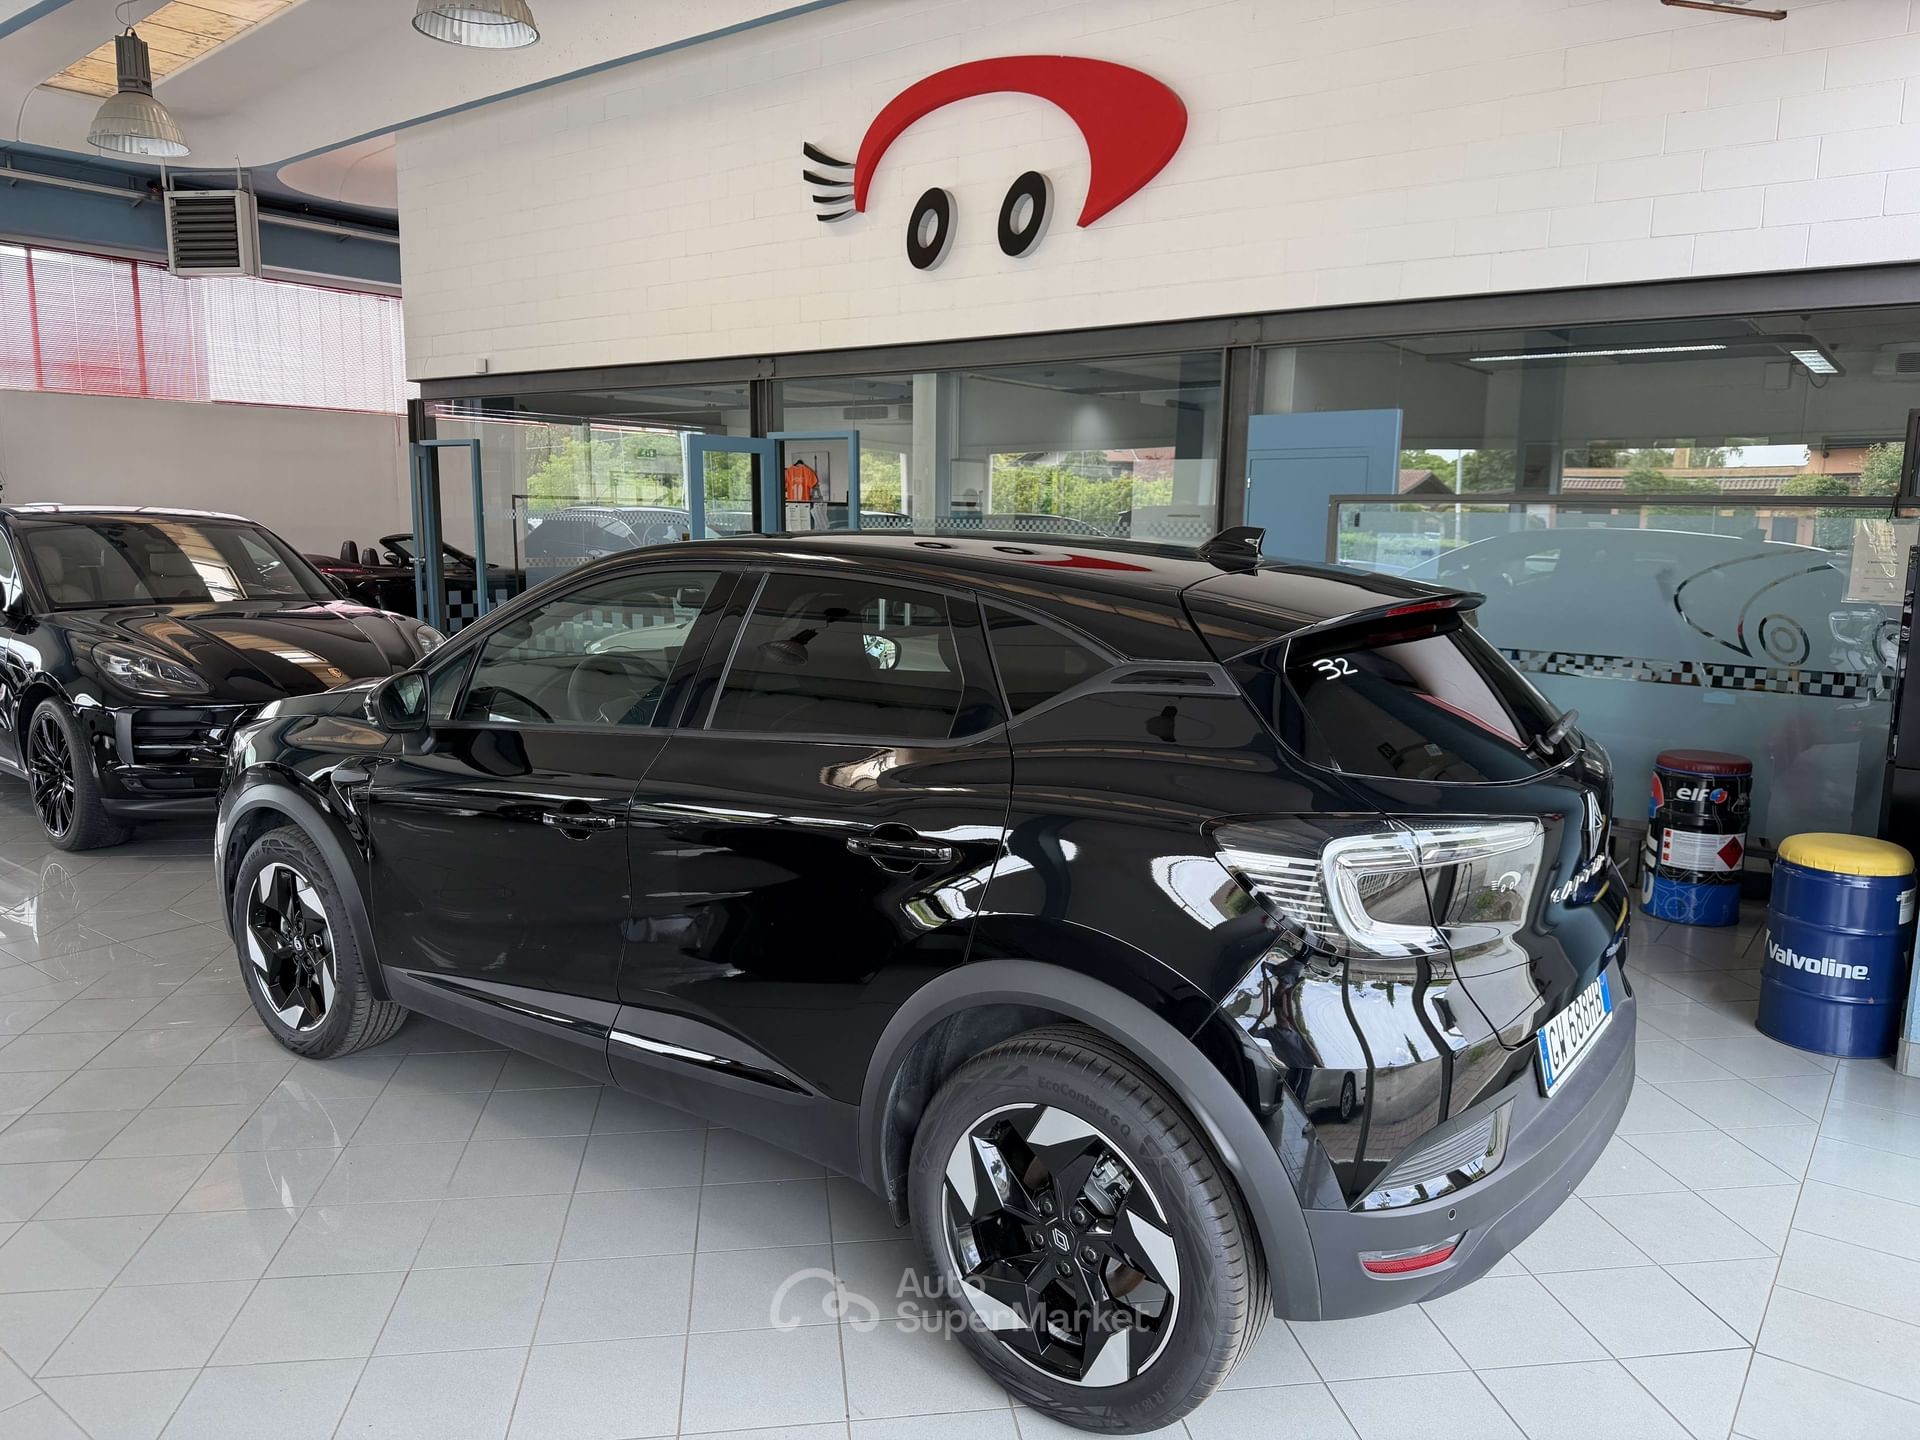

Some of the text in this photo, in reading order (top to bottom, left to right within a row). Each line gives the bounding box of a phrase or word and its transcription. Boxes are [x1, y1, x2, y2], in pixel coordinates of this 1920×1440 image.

[1311, 657, 1358, 681] 32
[1676, 787, 1710, 801] elf
[1038, 1076, 1111, 1118] EcoContact
